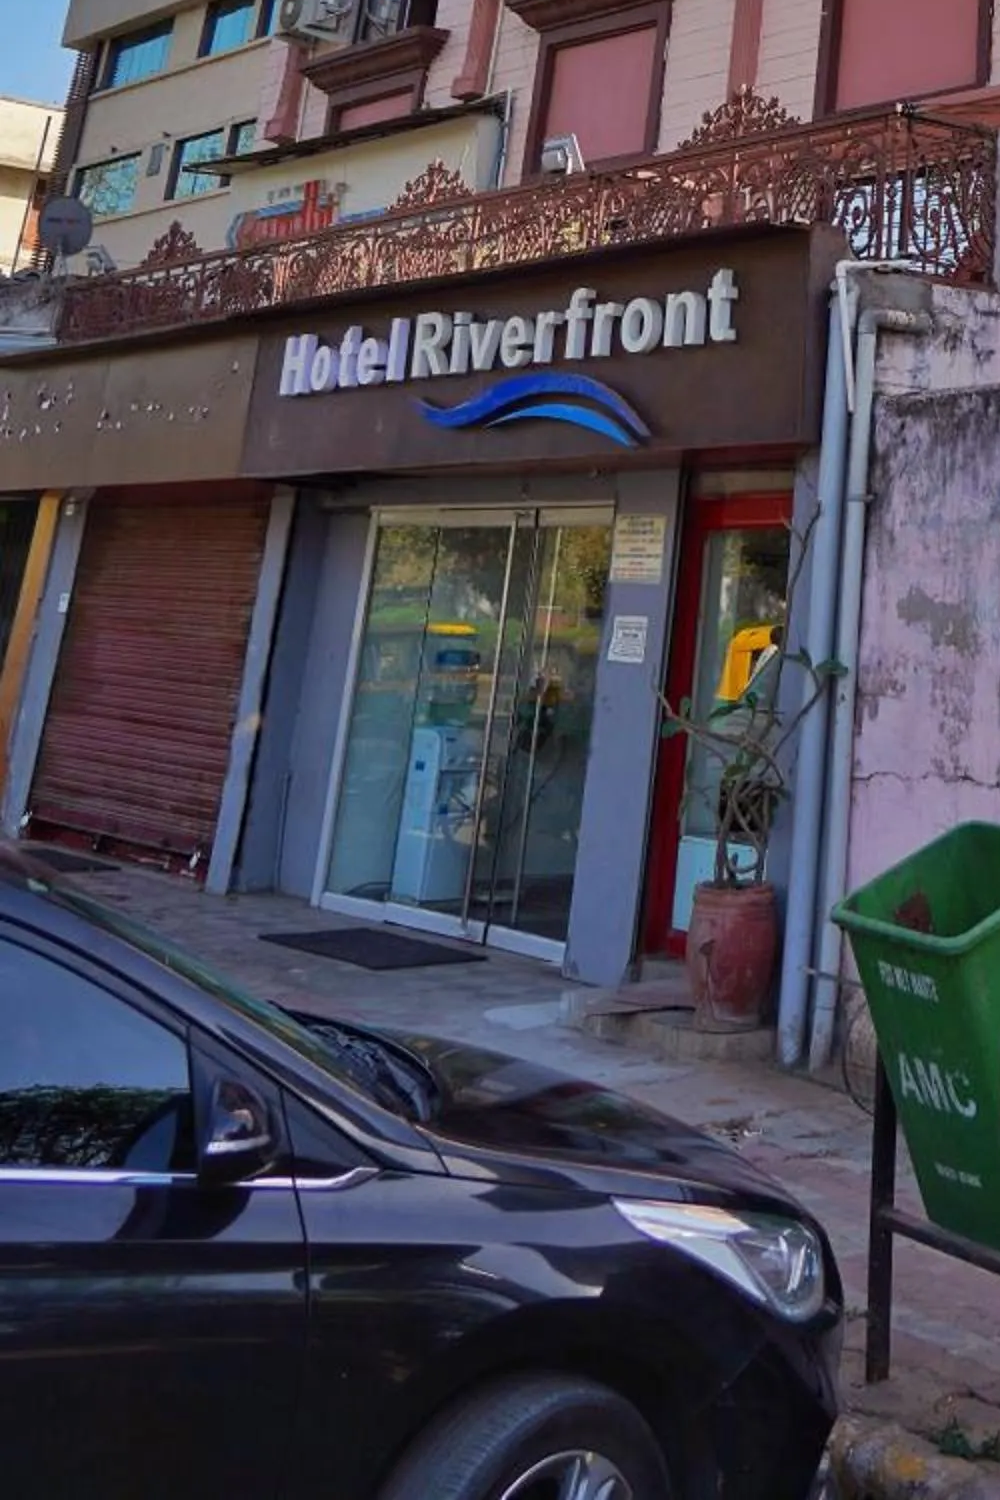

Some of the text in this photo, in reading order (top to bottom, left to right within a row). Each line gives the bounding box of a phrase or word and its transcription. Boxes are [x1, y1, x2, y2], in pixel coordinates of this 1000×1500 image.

[280, 268, 738, 395] Hotel Riverfront
[899, 1052, 977, 1118] AMC
